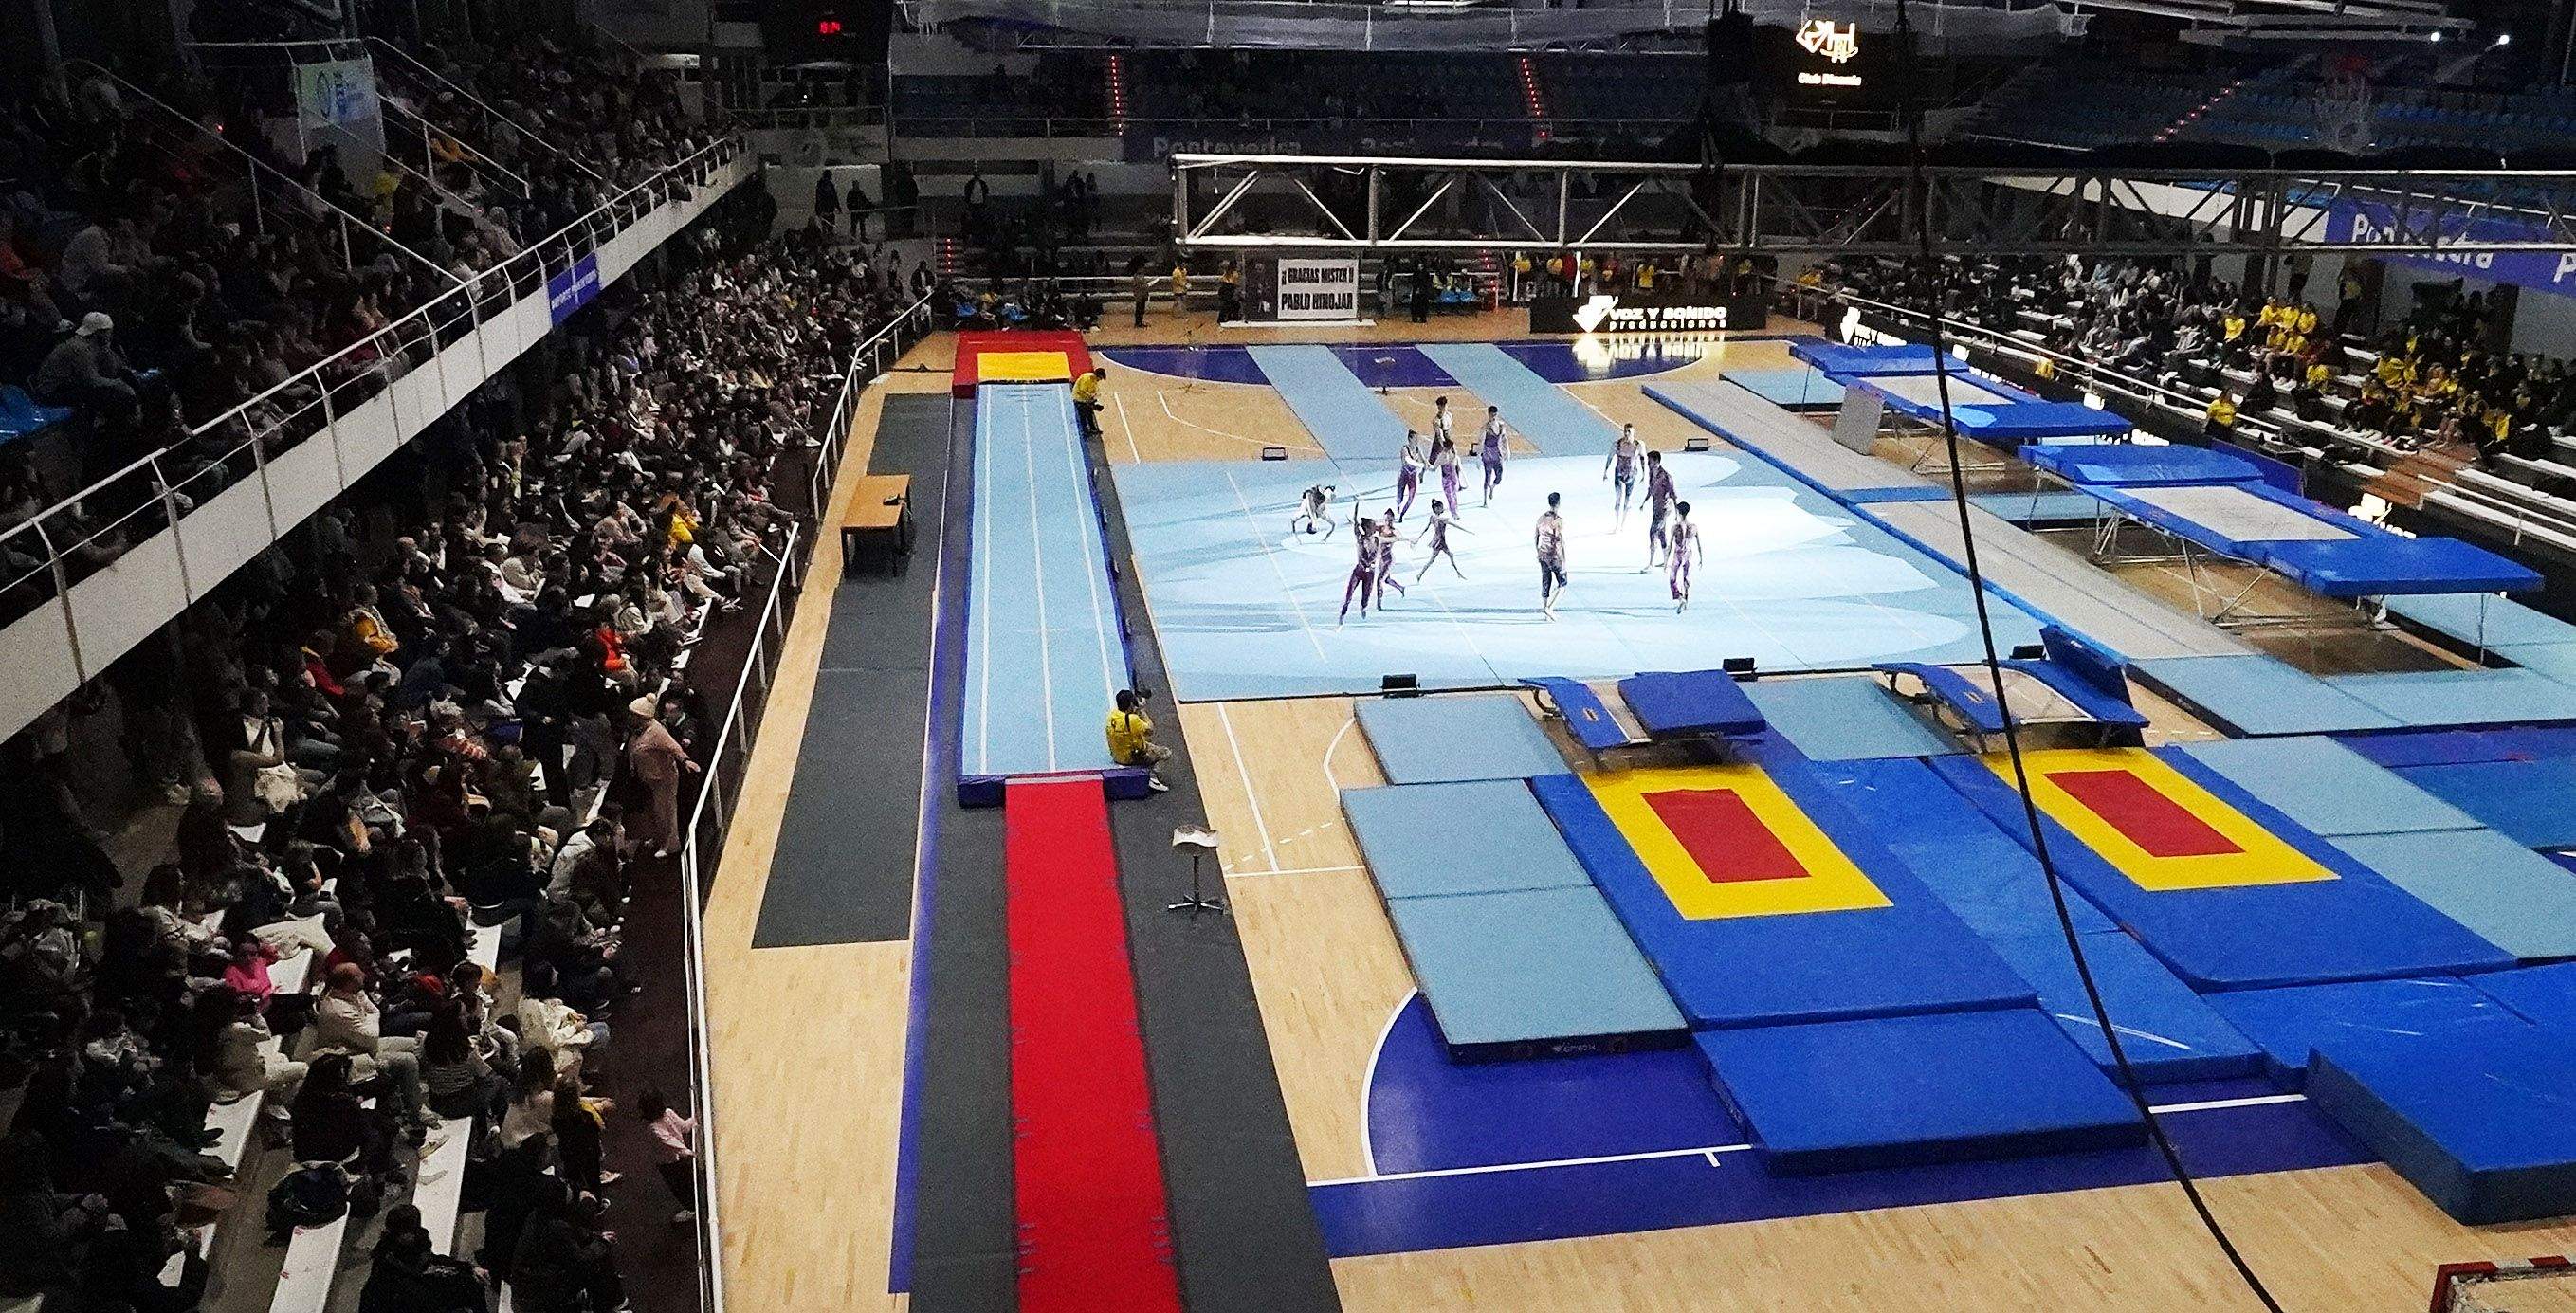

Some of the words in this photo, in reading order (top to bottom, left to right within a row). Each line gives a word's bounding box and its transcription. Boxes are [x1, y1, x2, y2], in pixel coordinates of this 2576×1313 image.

[1288, 268, 1320, 283] GRACIAS
[1321, 268, 1348, 283] MISTER
[1282, 293, 1310, 310] PABLO
[1312, 293, 1353, 310] HINOJAR
[1610, 308, 1645, 320] VOZ
[1647, 308, 1660, 320] Y
[1609, 319, 1726, 331] producciones
